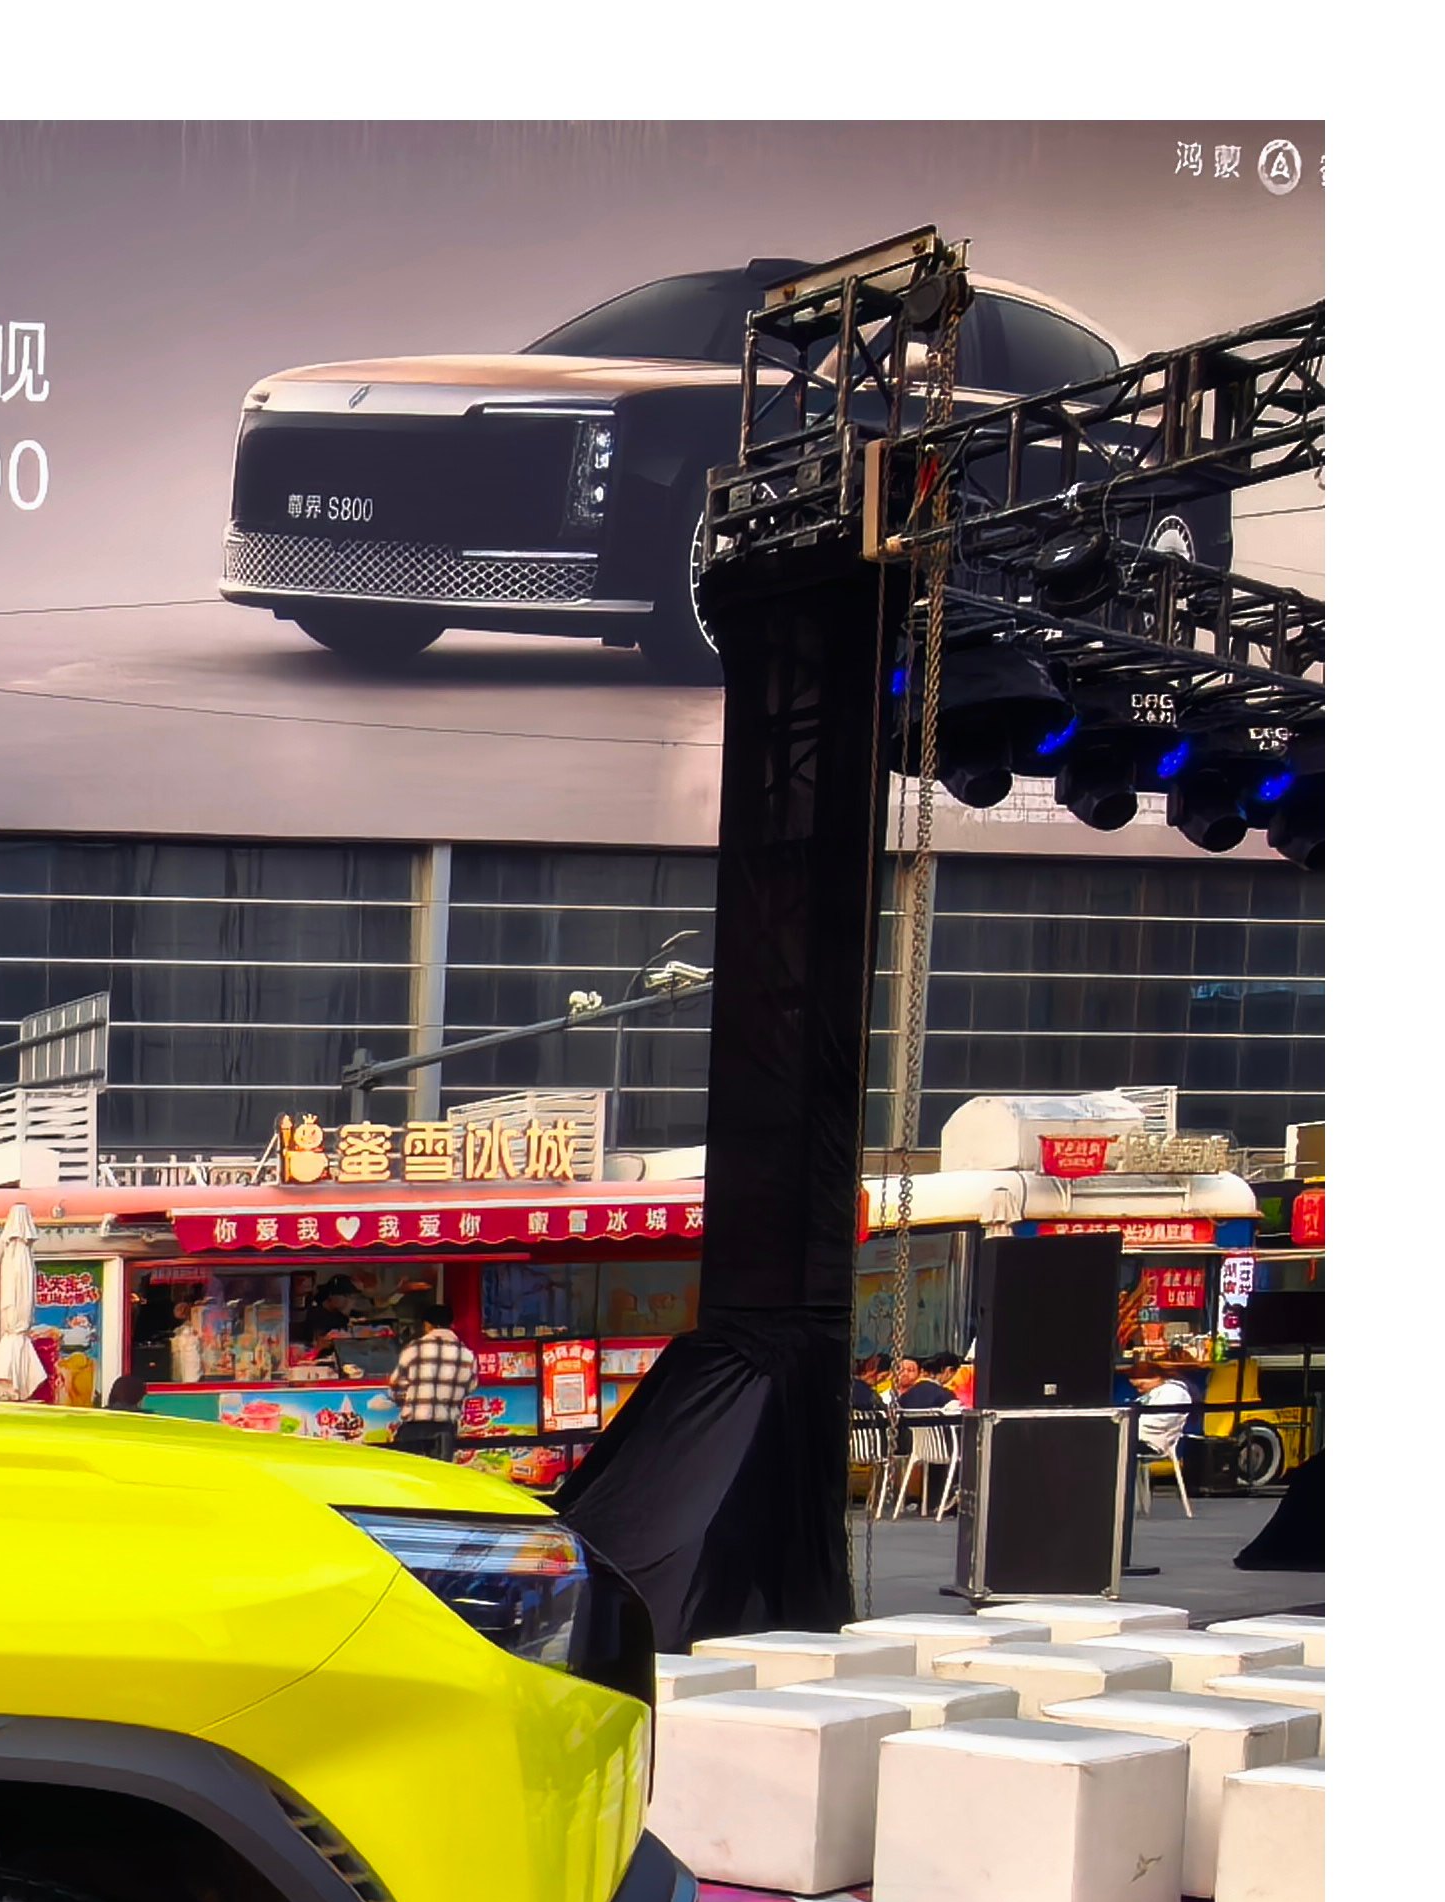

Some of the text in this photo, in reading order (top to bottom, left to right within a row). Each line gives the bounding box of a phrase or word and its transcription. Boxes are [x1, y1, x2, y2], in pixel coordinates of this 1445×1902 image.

[1174, 140, 1242, 178] 鸿蒙
[287, 494, 373, 523] 尊界 S800
[338, 1119, 577, 1183] 蜜雪冰城
[214, 1217, 321, 1243] 你爱我
[377, 1213, 482, 1239] 我爱你
